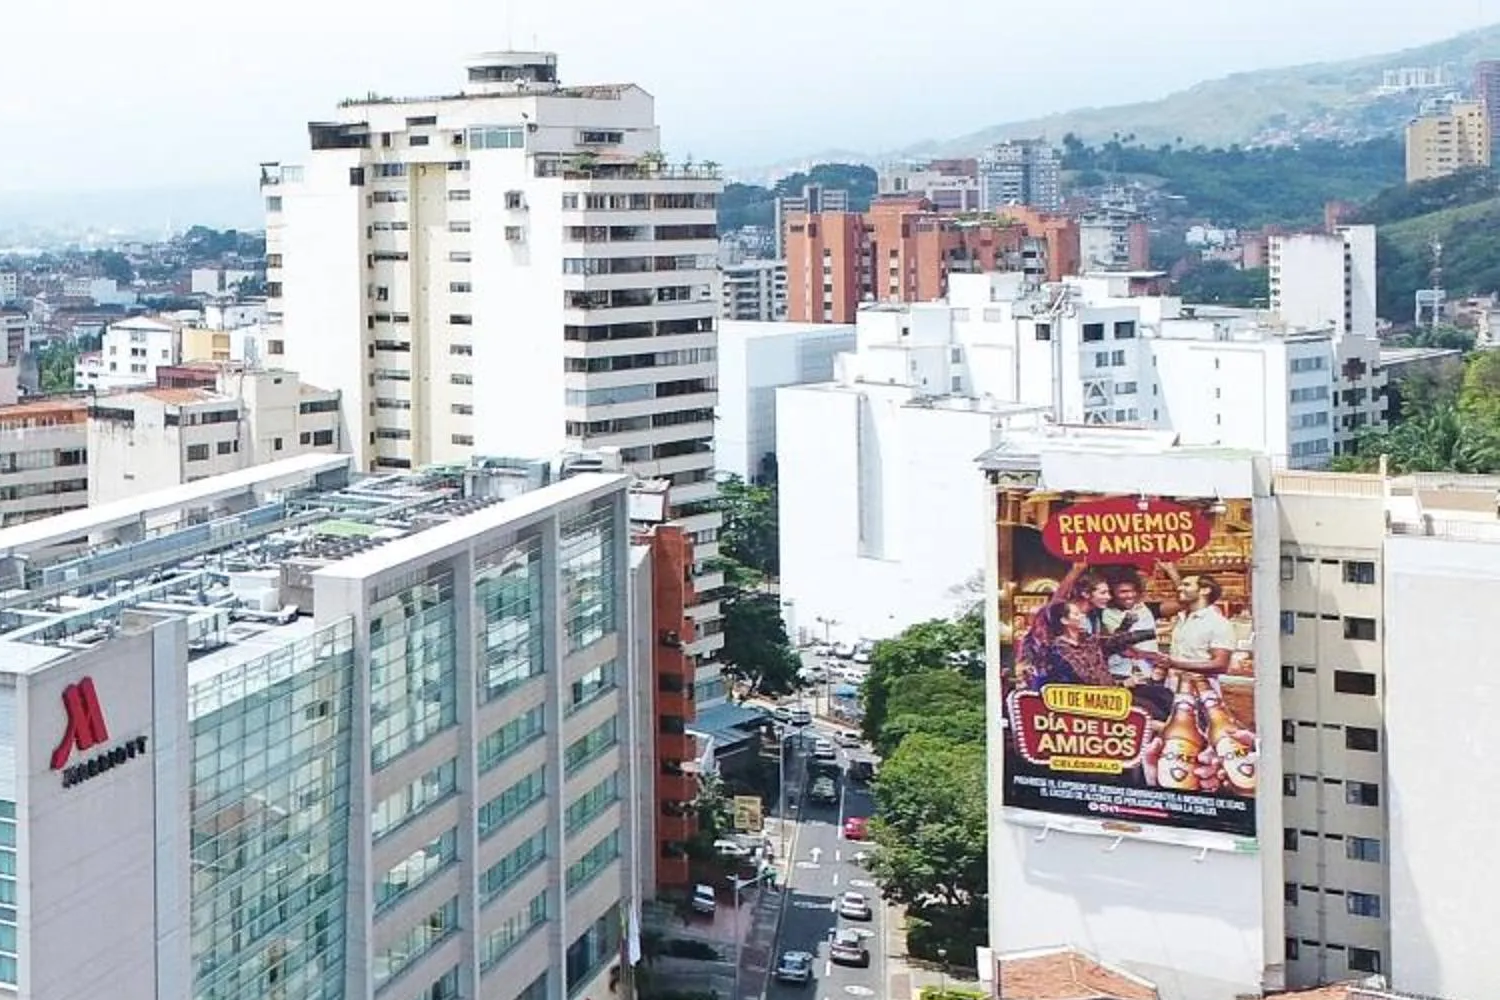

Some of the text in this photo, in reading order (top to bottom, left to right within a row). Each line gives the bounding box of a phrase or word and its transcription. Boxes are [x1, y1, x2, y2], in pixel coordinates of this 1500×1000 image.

[1059, 511, 1193, 533] RENOVEMOS
[1062, 533, 1195, 554] LA AMISTAD
[1052, 690, 1123, 711] 11 DE MARZO
[1033, 712, 1137, 737] DÍA DE LOS
[1037, 733, 1136, 757] AMIGOS
